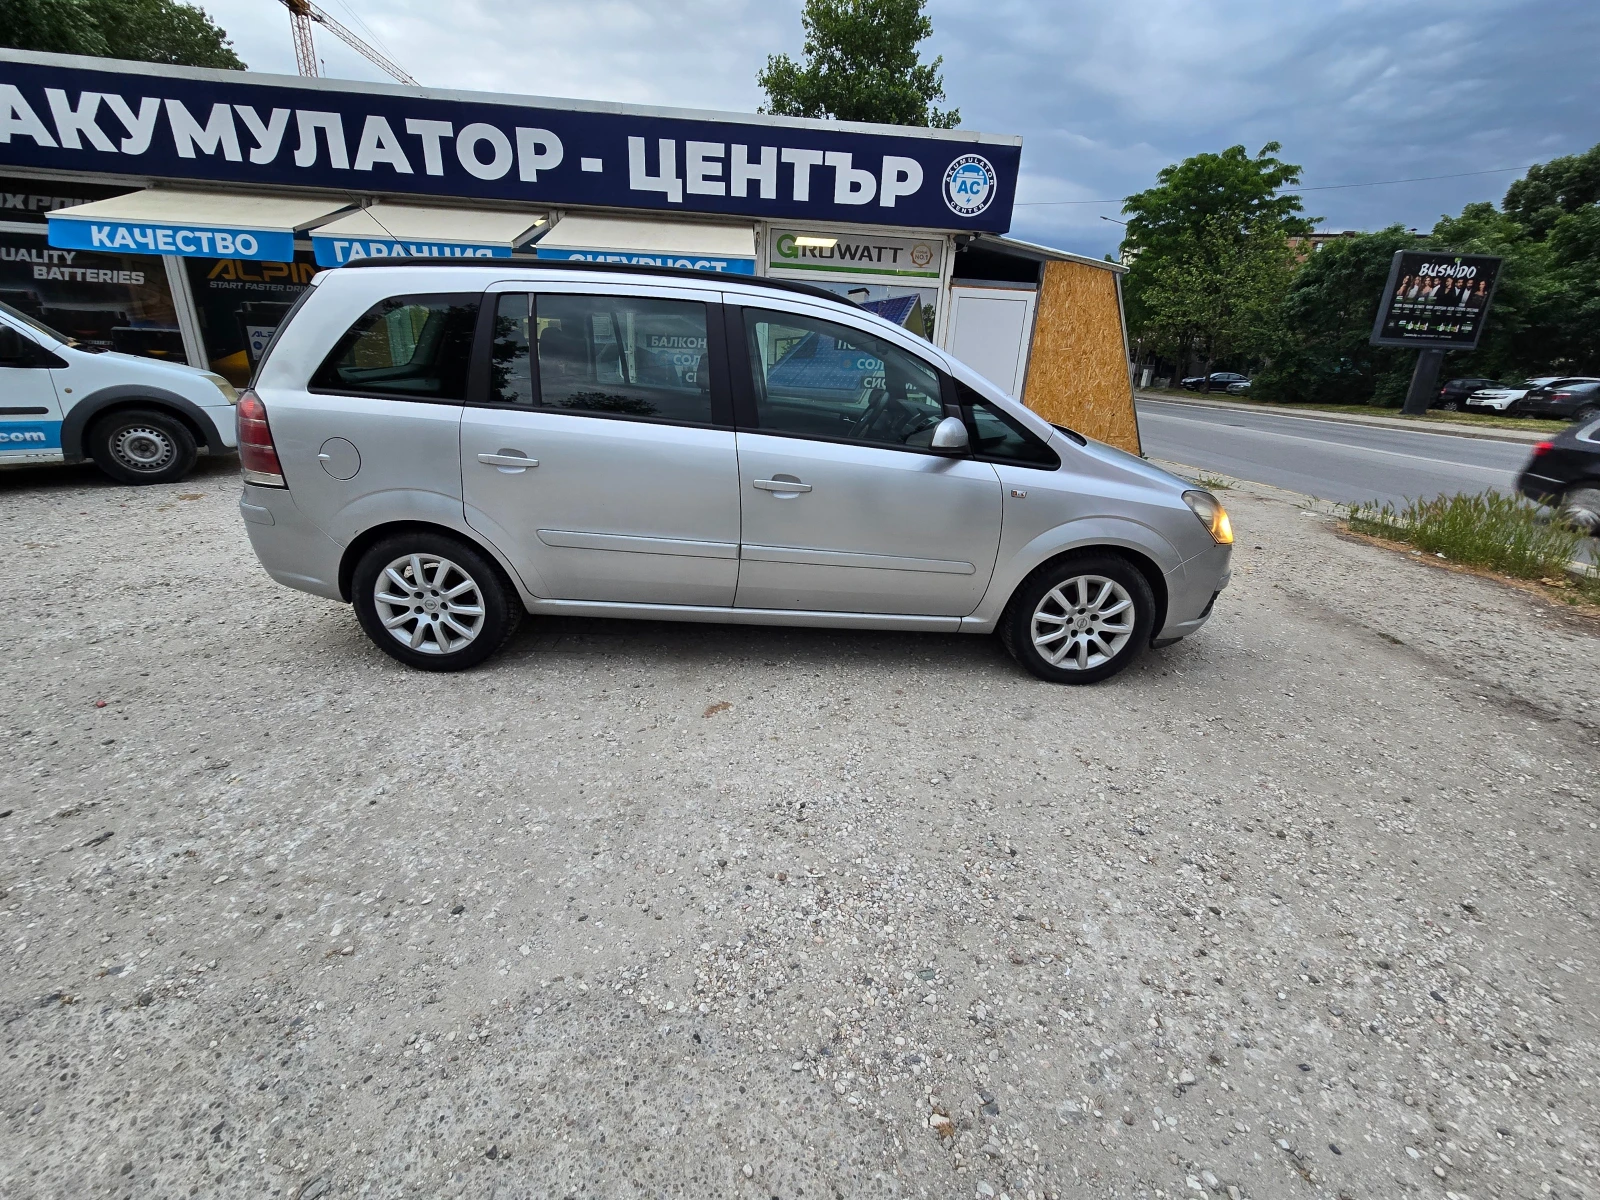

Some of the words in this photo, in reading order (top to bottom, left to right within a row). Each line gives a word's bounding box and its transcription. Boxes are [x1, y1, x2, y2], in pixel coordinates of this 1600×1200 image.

[0, 84, 564, 183] АКУМУЛАТОР
[627, 135, 924, 208] ЦЕНТЪР
[946, 157, 994, 186] AKUMULATOR
[956, 180, 981, 195] AC
[950, 201, 985, 214] CENTER
[90, 224, 259, 256] КАЧЕСТВО
[776, 233, 904, 264] GROWATT
[33, 265, 145, 285] BATTERIES
[207, 258, 317, 286] ALPIN
[1418, 260, 1477, 278] BUSHIDO
[209, 281, 243, 289] START
[245, 283, 284, 292] FASTER
